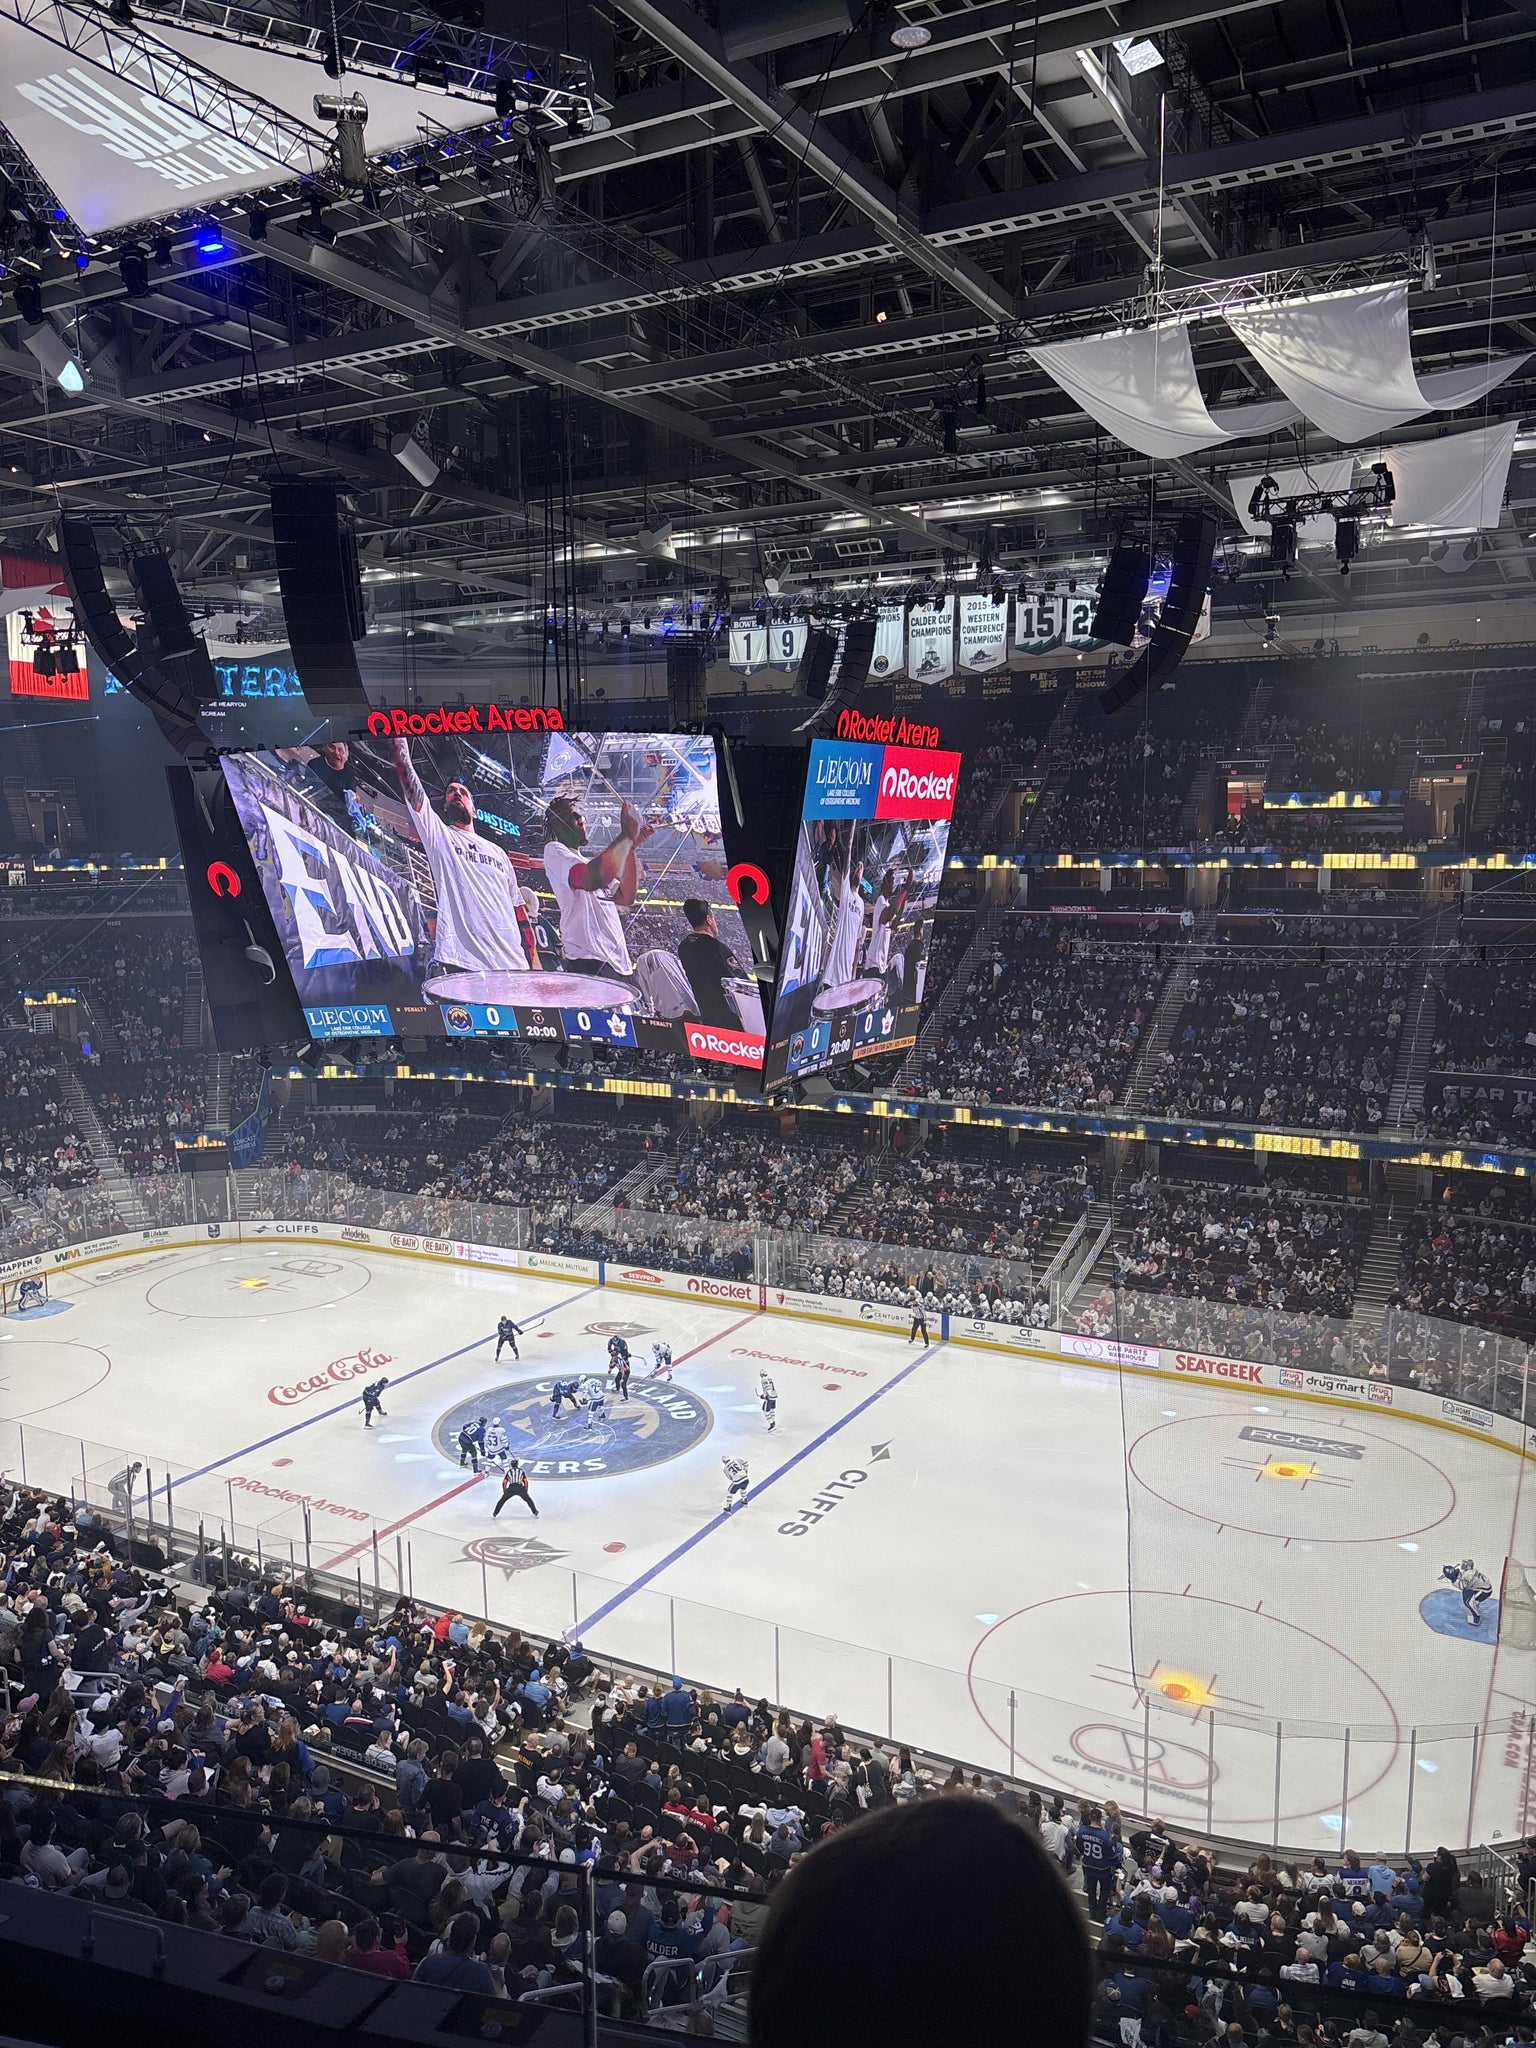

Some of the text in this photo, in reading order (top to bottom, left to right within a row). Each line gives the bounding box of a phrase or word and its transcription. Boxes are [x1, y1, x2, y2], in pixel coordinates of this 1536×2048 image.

[134, 152, 230, 190] THE
[911, 614, 952, 627] CALDER CUP
[967, 613, 1000, 623] WESTERN
[1024, 606, 1054, 638] 15
[911, 626, 952, 638] CHAMPIONS
[962, 623, 1005, 634] CONFERENCE
[743, 633, 751, 660] 1
[782, 630, 794, 657] 9
[963, 634, 1003, 645] CHAMPIONS
[390, 704, 564, 735] Rocket Arena
[849, 710, 939, 747] Rocket Arena
[816, 756, 873, 787] LECOM
[896, 767, 955, 800] Rocket
[476, 807, 521, 837] ONSTERS
[308, 1008, 389, 1026] LECOM
[485, 1007, 500, 1026] 0
[577, 1011, 591, 1031] 0
[649, 1019, 672, 1028] PENALTY
[864, 1013, 873, 1034] 0
[525, 1025, 557, 1037] 20:00
[811, 1029, 819, 1049] 0
[706, 1034, 764, 1060] Rocket
[829, 1038, 851, 1056] 20:00
[1443, 1085, 1505, 1101] FEAR
[276, 1224, 319, 1234] CLIFFS
[54, 1248, 81, 1263] WM
[425, 1239, 449, 1254] RE-BATH
[0, 1257, 33, 1273] HAPPEN
[539, 1258, 589, 1272] MEDICAL MUTUAL
[628, 1272, 656, 1282] SERVPRO
[701, 1279, 752, 1300] Rocket
[873, 1311, 905, 1322] CENTURY
[1107, 1344, 1148, 1356] CAR PARTS
[746, 1350, 869, 1378] Rocket Arena
[1175, 1354, 1263, 1384] SEATGEEK
[268, 1347, 393, 1406] Coca-Cola
[1281, 1370, 1299, 1380] drug
[1306, 1376, 1365, 1394] drug mart
[1370, 1384, 1389, 1396] drug
[242, 1480, 370, 1521] Rocket Arena
[777, 1469, 868, 1537] CLIFFS
[1052, 1754, 1080, 1769] CAR
[1081, 1763, 1126, 1782] PARTS
[646, 1940, 679, 1956] CALDER
